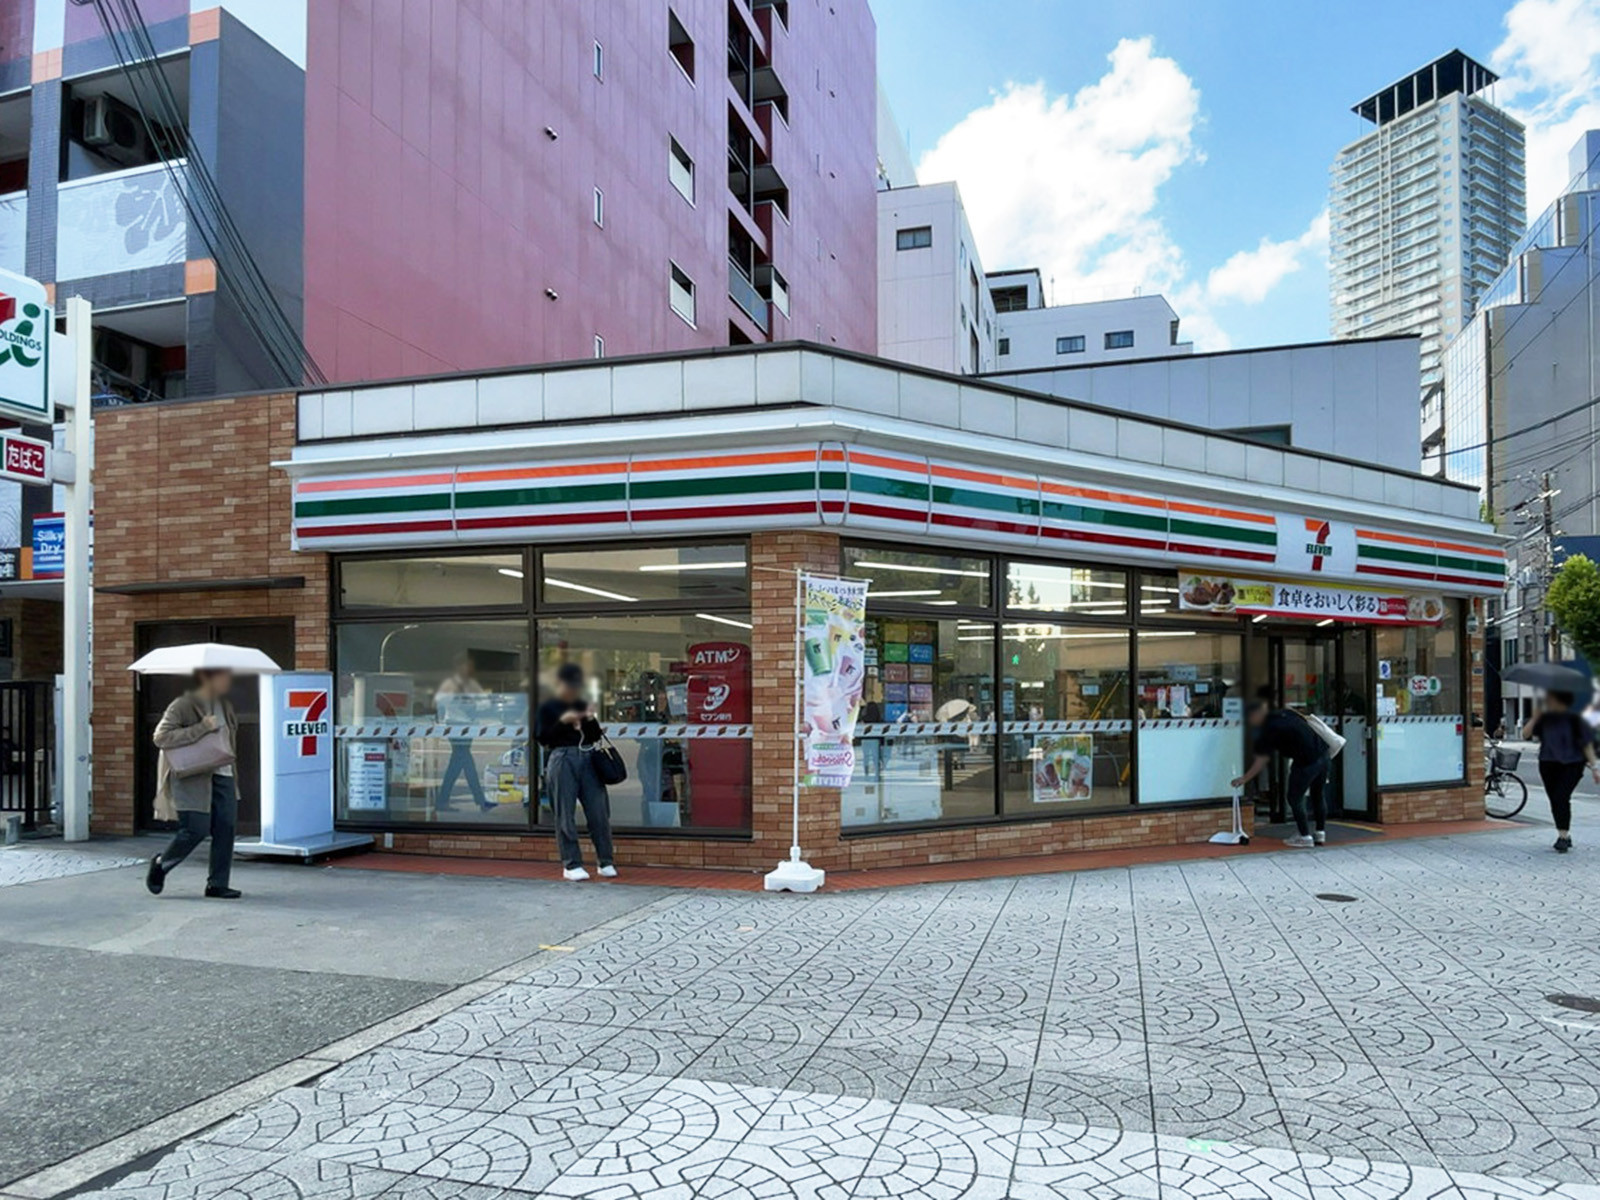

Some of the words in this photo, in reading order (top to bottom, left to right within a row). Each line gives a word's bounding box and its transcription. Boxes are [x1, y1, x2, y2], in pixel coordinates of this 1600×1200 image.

[8, 444, 43, 472] たばこ
[40, 543, 60, 555] Dry
[1278, 587, 1376, 613] 食卓をおいしく彩る
[694, 650, 728, 663] ATM
